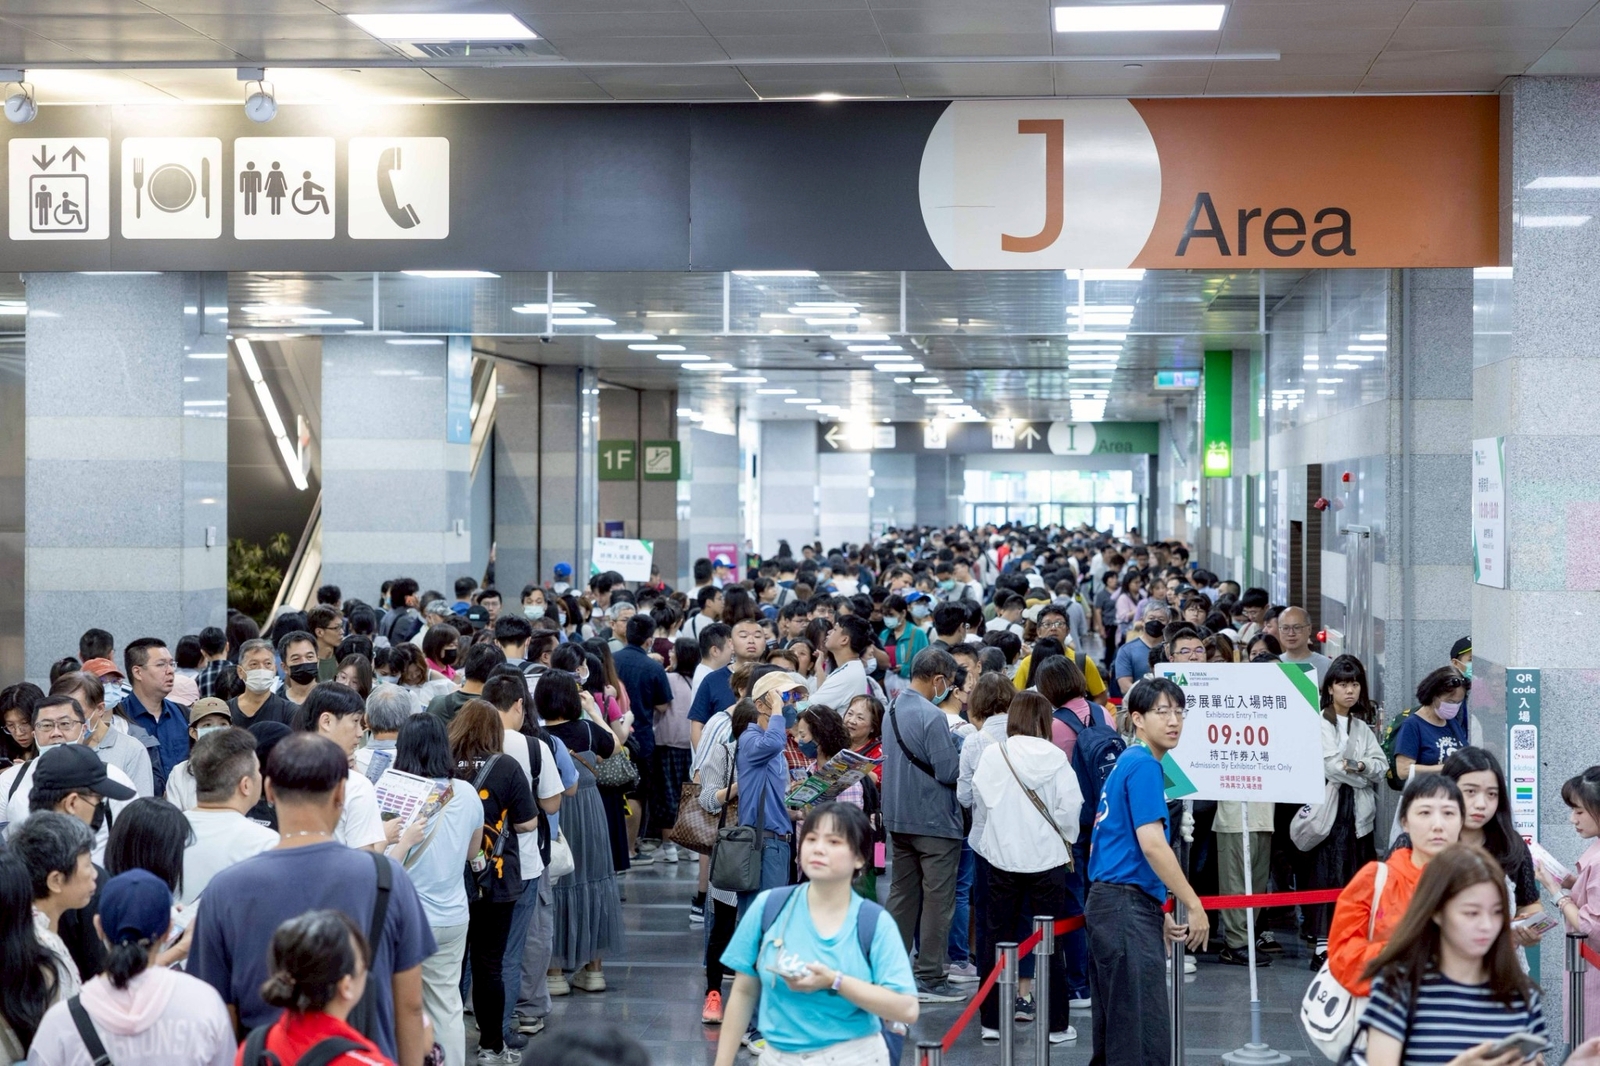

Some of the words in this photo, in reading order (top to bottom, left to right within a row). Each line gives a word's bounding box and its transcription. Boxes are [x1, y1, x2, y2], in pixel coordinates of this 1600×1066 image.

[1001, 119, 1064, 253] J
[1174, 192, 1356, 257] Area
[1067, 424, 1077, 450] I
[1098, 439, 1133, 453] Area
[603, 450, 632, 470] 1F
[1516, 673, 1533, 683] QR
[1512, 685, 1537, 694] code
[1186, 694, 1288, 709] 參展單位入場時間
[1206, 711, 1235, 719] Exhibitors
[1236, 711, 1252, 720] Entry
[1518, 697, 1531, 722] 入場
[1207, 724, 1269, 746] 09:00
[1190, 761, 1220, 769] Admission
[1221, 762, 1229, 771] By
[1230, 762, 1256, 770] Exhibitor
[1258, 763, 1276, 771] Ticket
[1277, 764, 1292, 773] Only
[1513, 764, 1536, 774] kkday
